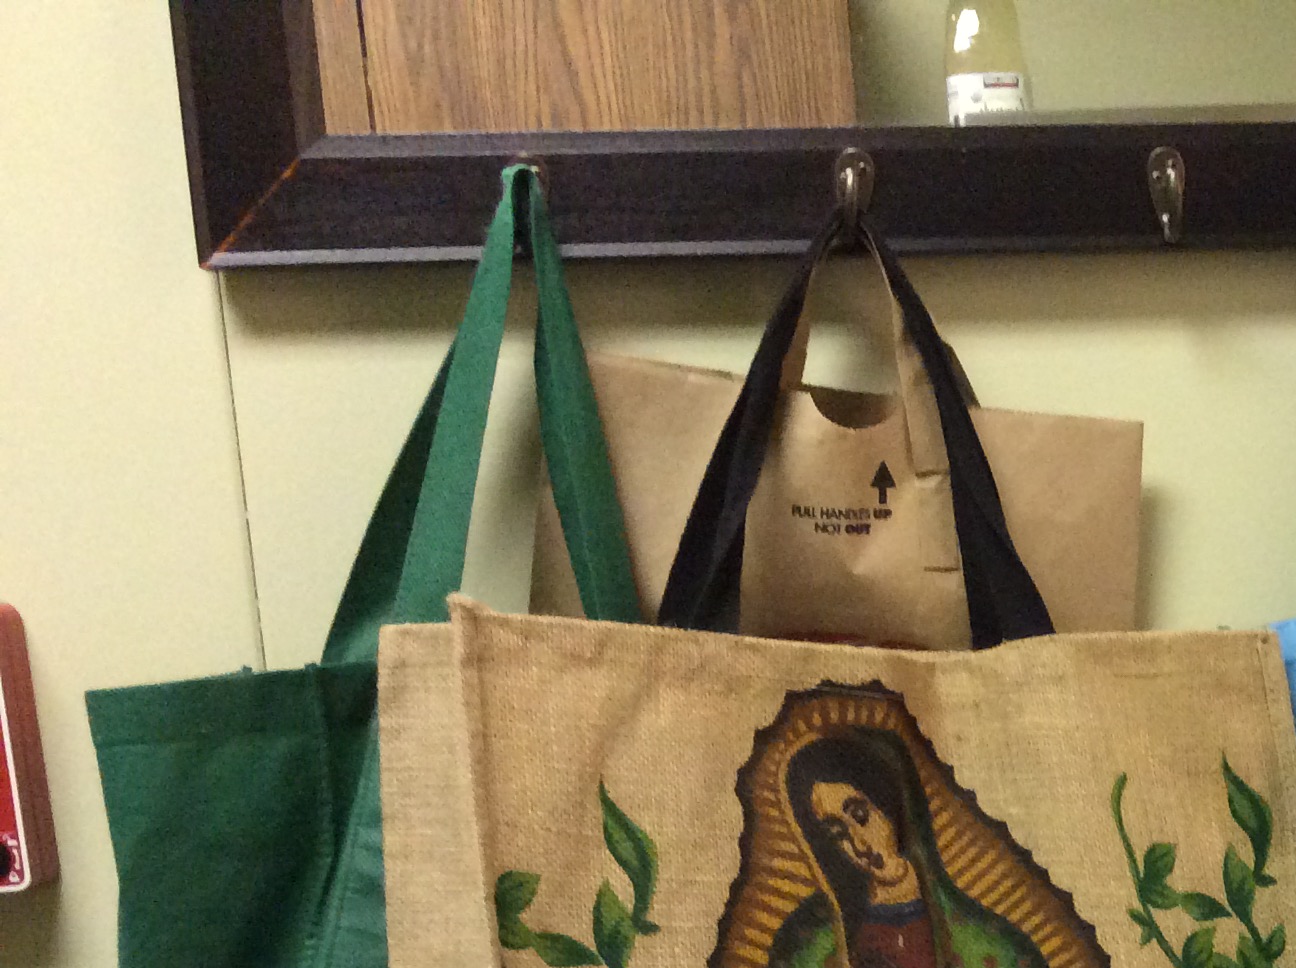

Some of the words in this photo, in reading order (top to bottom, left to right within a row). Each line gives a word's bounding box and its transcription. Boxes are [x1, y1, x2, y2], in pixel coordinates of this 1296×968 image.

[791, 504, 816, 518] PULL
[873, 506, 893, 520] UP
[814, 522, 841, 535] NOT
[844, 523, 871, 535] OUT
